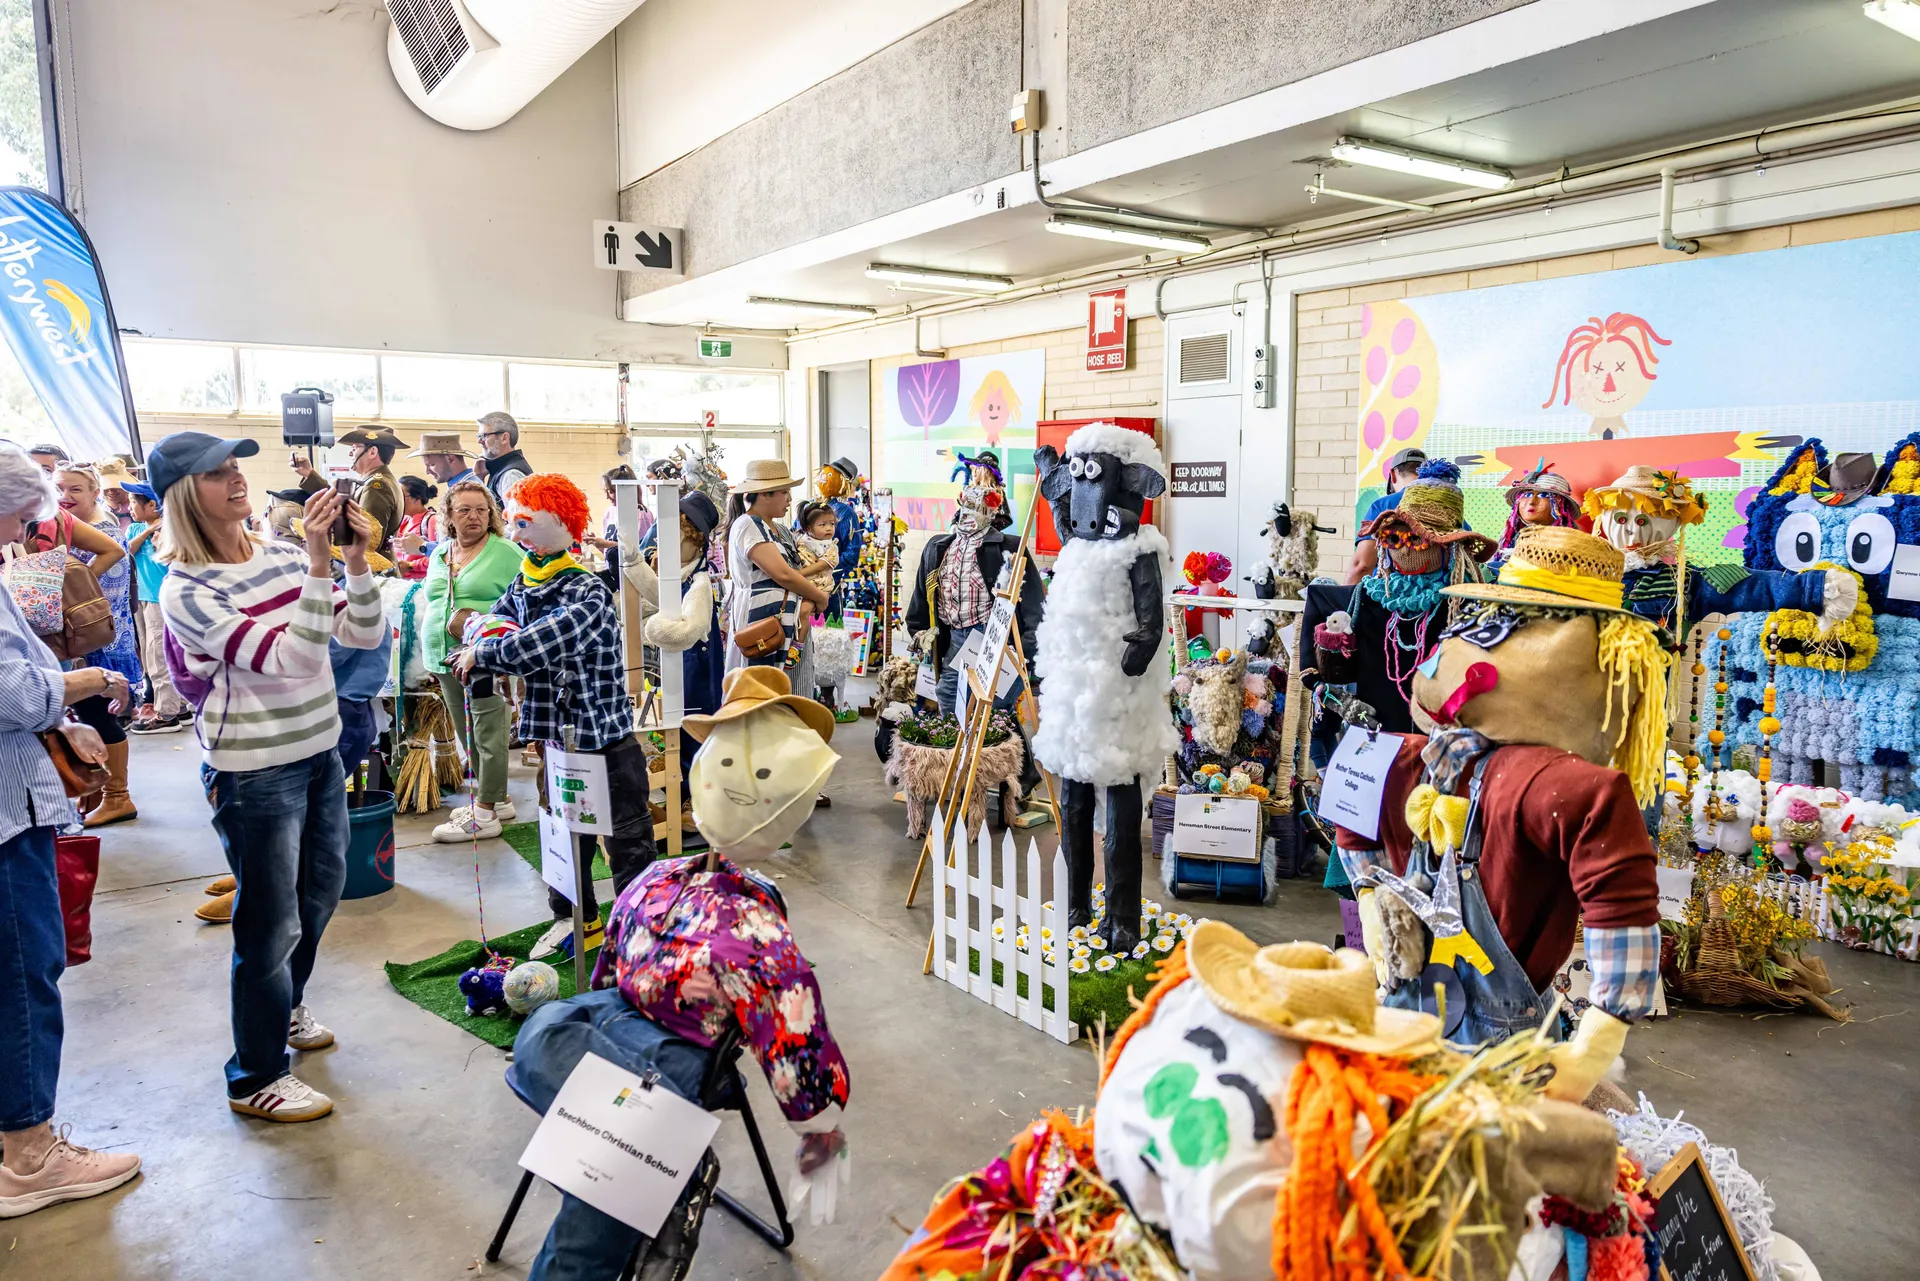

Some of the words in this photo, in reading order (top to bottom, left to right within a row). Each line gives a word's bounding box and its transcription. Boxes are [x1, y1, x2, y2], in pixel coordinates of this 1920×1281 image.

[1087, 354, 1105, 367] HOSE
[1106, 352, 1123, 365] REEL
[286, 406, 313, 415] MIPRO
[705, 411, 715, 428] 2
[1175, 467, 1190, 478] KEEP
[1191, 465, 1223, 478] DOORWAY
[1171, 480, 1189, 492] CLEAR
[1189, 480, 1200, 494] at
[1199, 480, 1209, 492] ALL
[1208, 480, 1225, 492] TIMES
[1895, 569, 1918, 577] Gwynne
[1335, 762, 1348, 774] Mother
[1348, 767, 1360, 778] Teresa
[1360, 771, 1376, 784] Catholic
[1344, 779, 1359, 791] College
[1178, 821, 1204, 829] Hensman
[1220, 825, 1252, 834] Elementary
[1665, 895, 1680, 903] Girls
[556, 1107, 601, 1136] Beechboro
[601, 1130, 644, 1161] Christian
[644, 1154, 679, 1179] School
[1675, 1189, 1699, 1223] the
[1701, 1233, 1724, 1266] from
